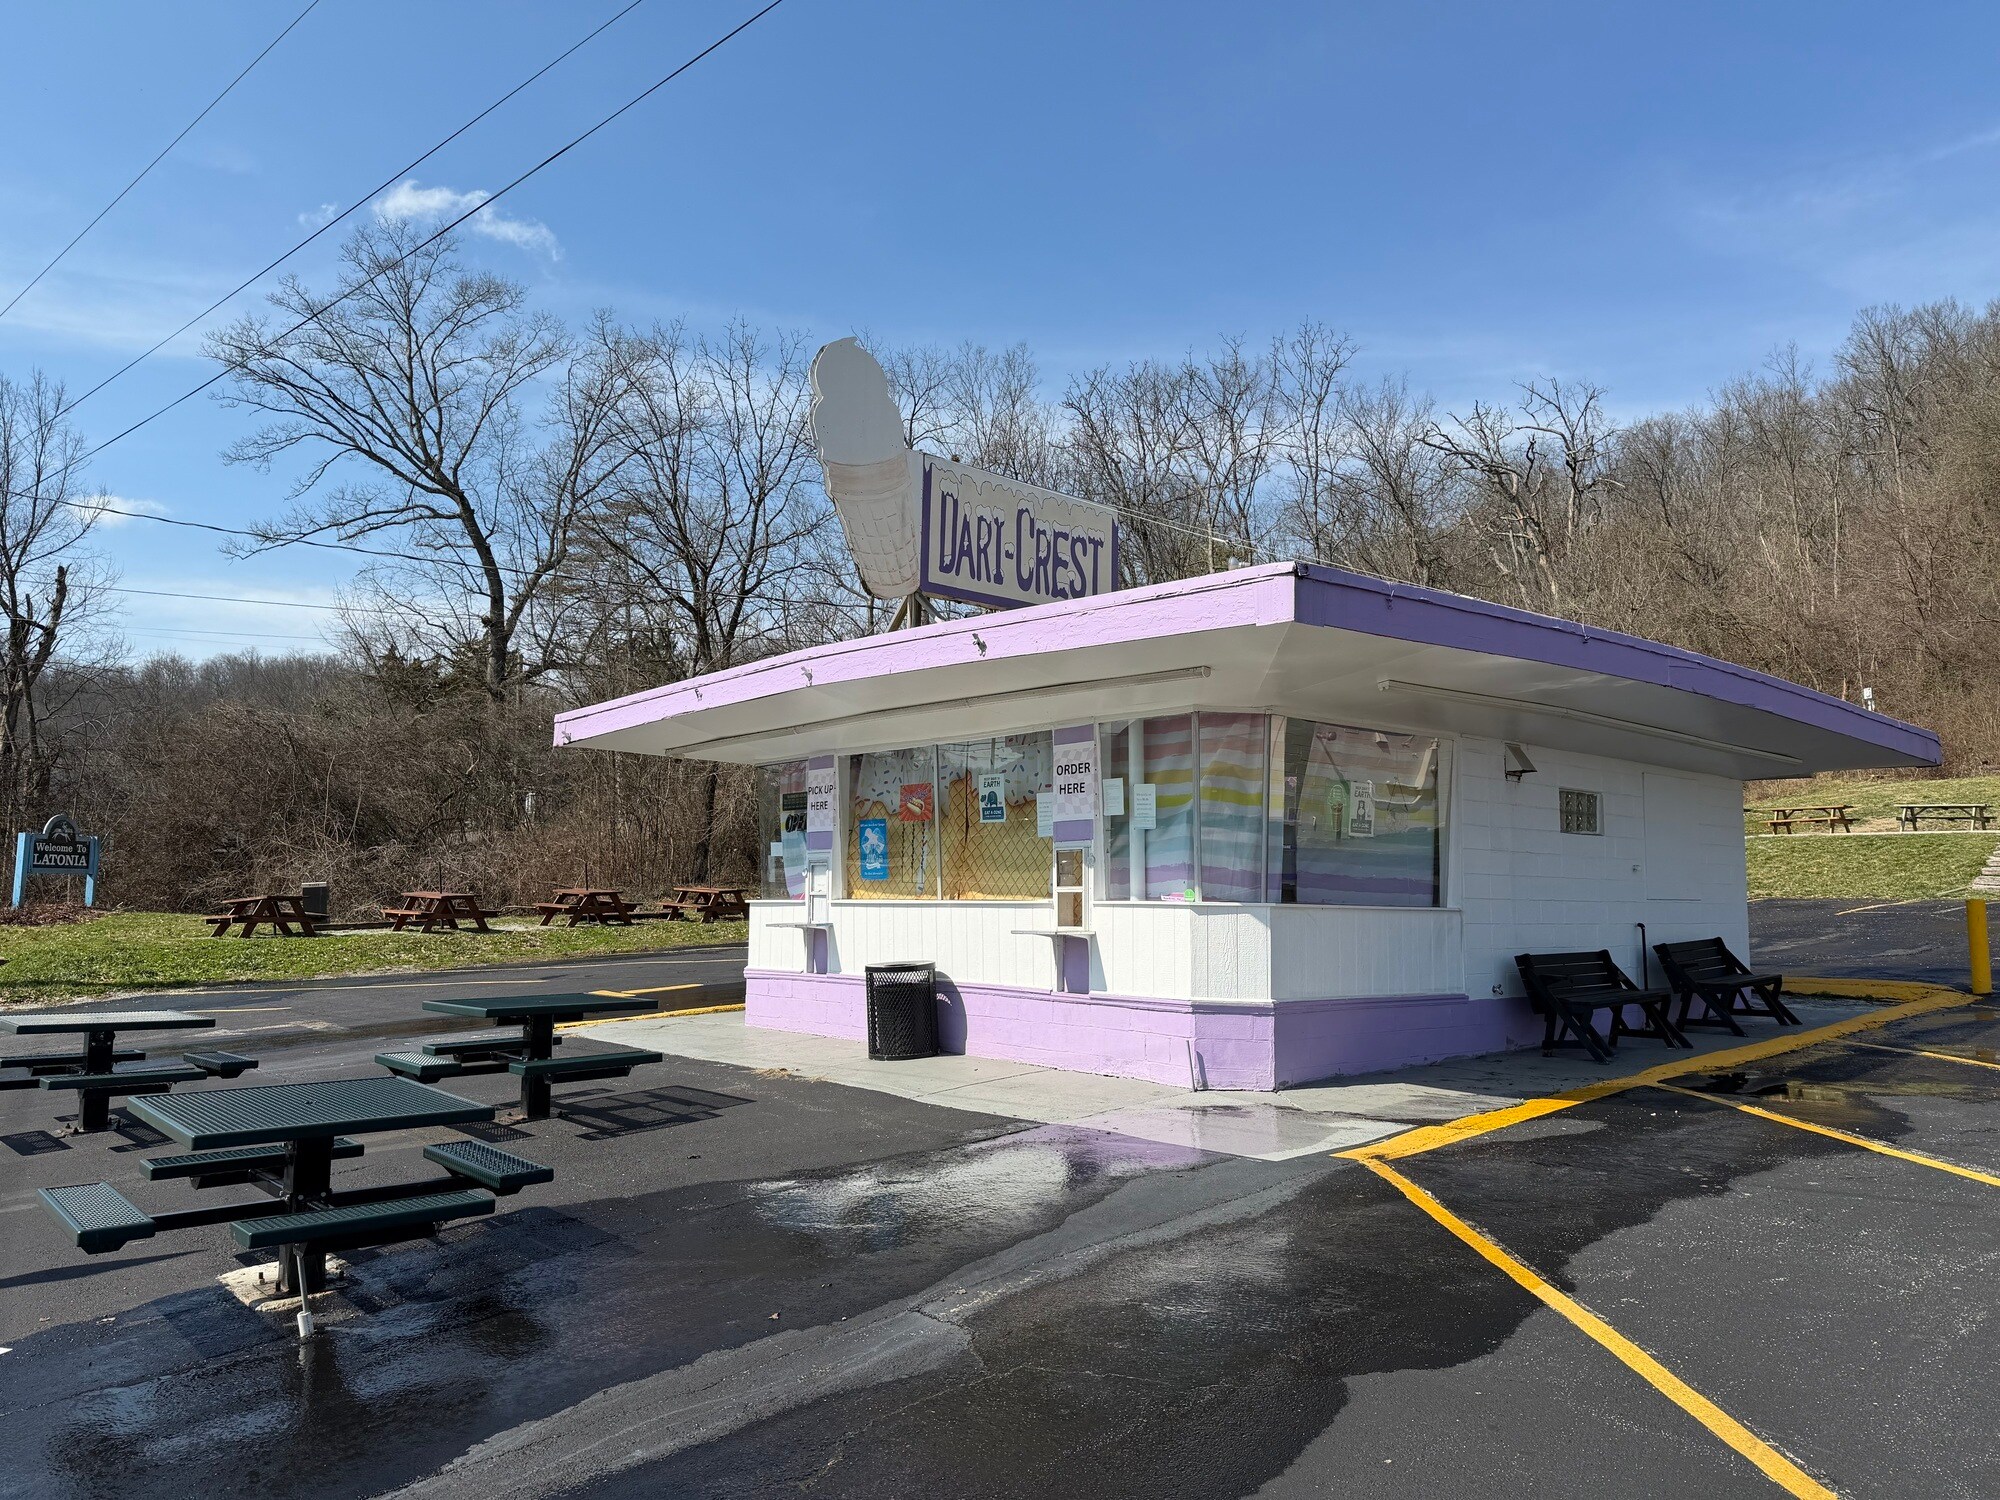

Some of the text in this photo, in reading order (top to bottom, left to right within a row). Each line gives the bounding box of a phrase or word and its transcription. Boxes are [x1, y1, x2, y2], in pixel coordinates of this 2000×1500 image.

[939, 481, 1104, 599] DARI-CREST
[1056, 762, 1091, 776] ORDER
[808, 784, 834, 795] PICK UP
[983, 780, 1001, 788] EARTH
[1059, 782, 1086, 795] HERE
[810, 801, 829, 811] HERE
[36, 842, 87, 853] Welcome To
[33, 853, 87, 866] LATONIA
